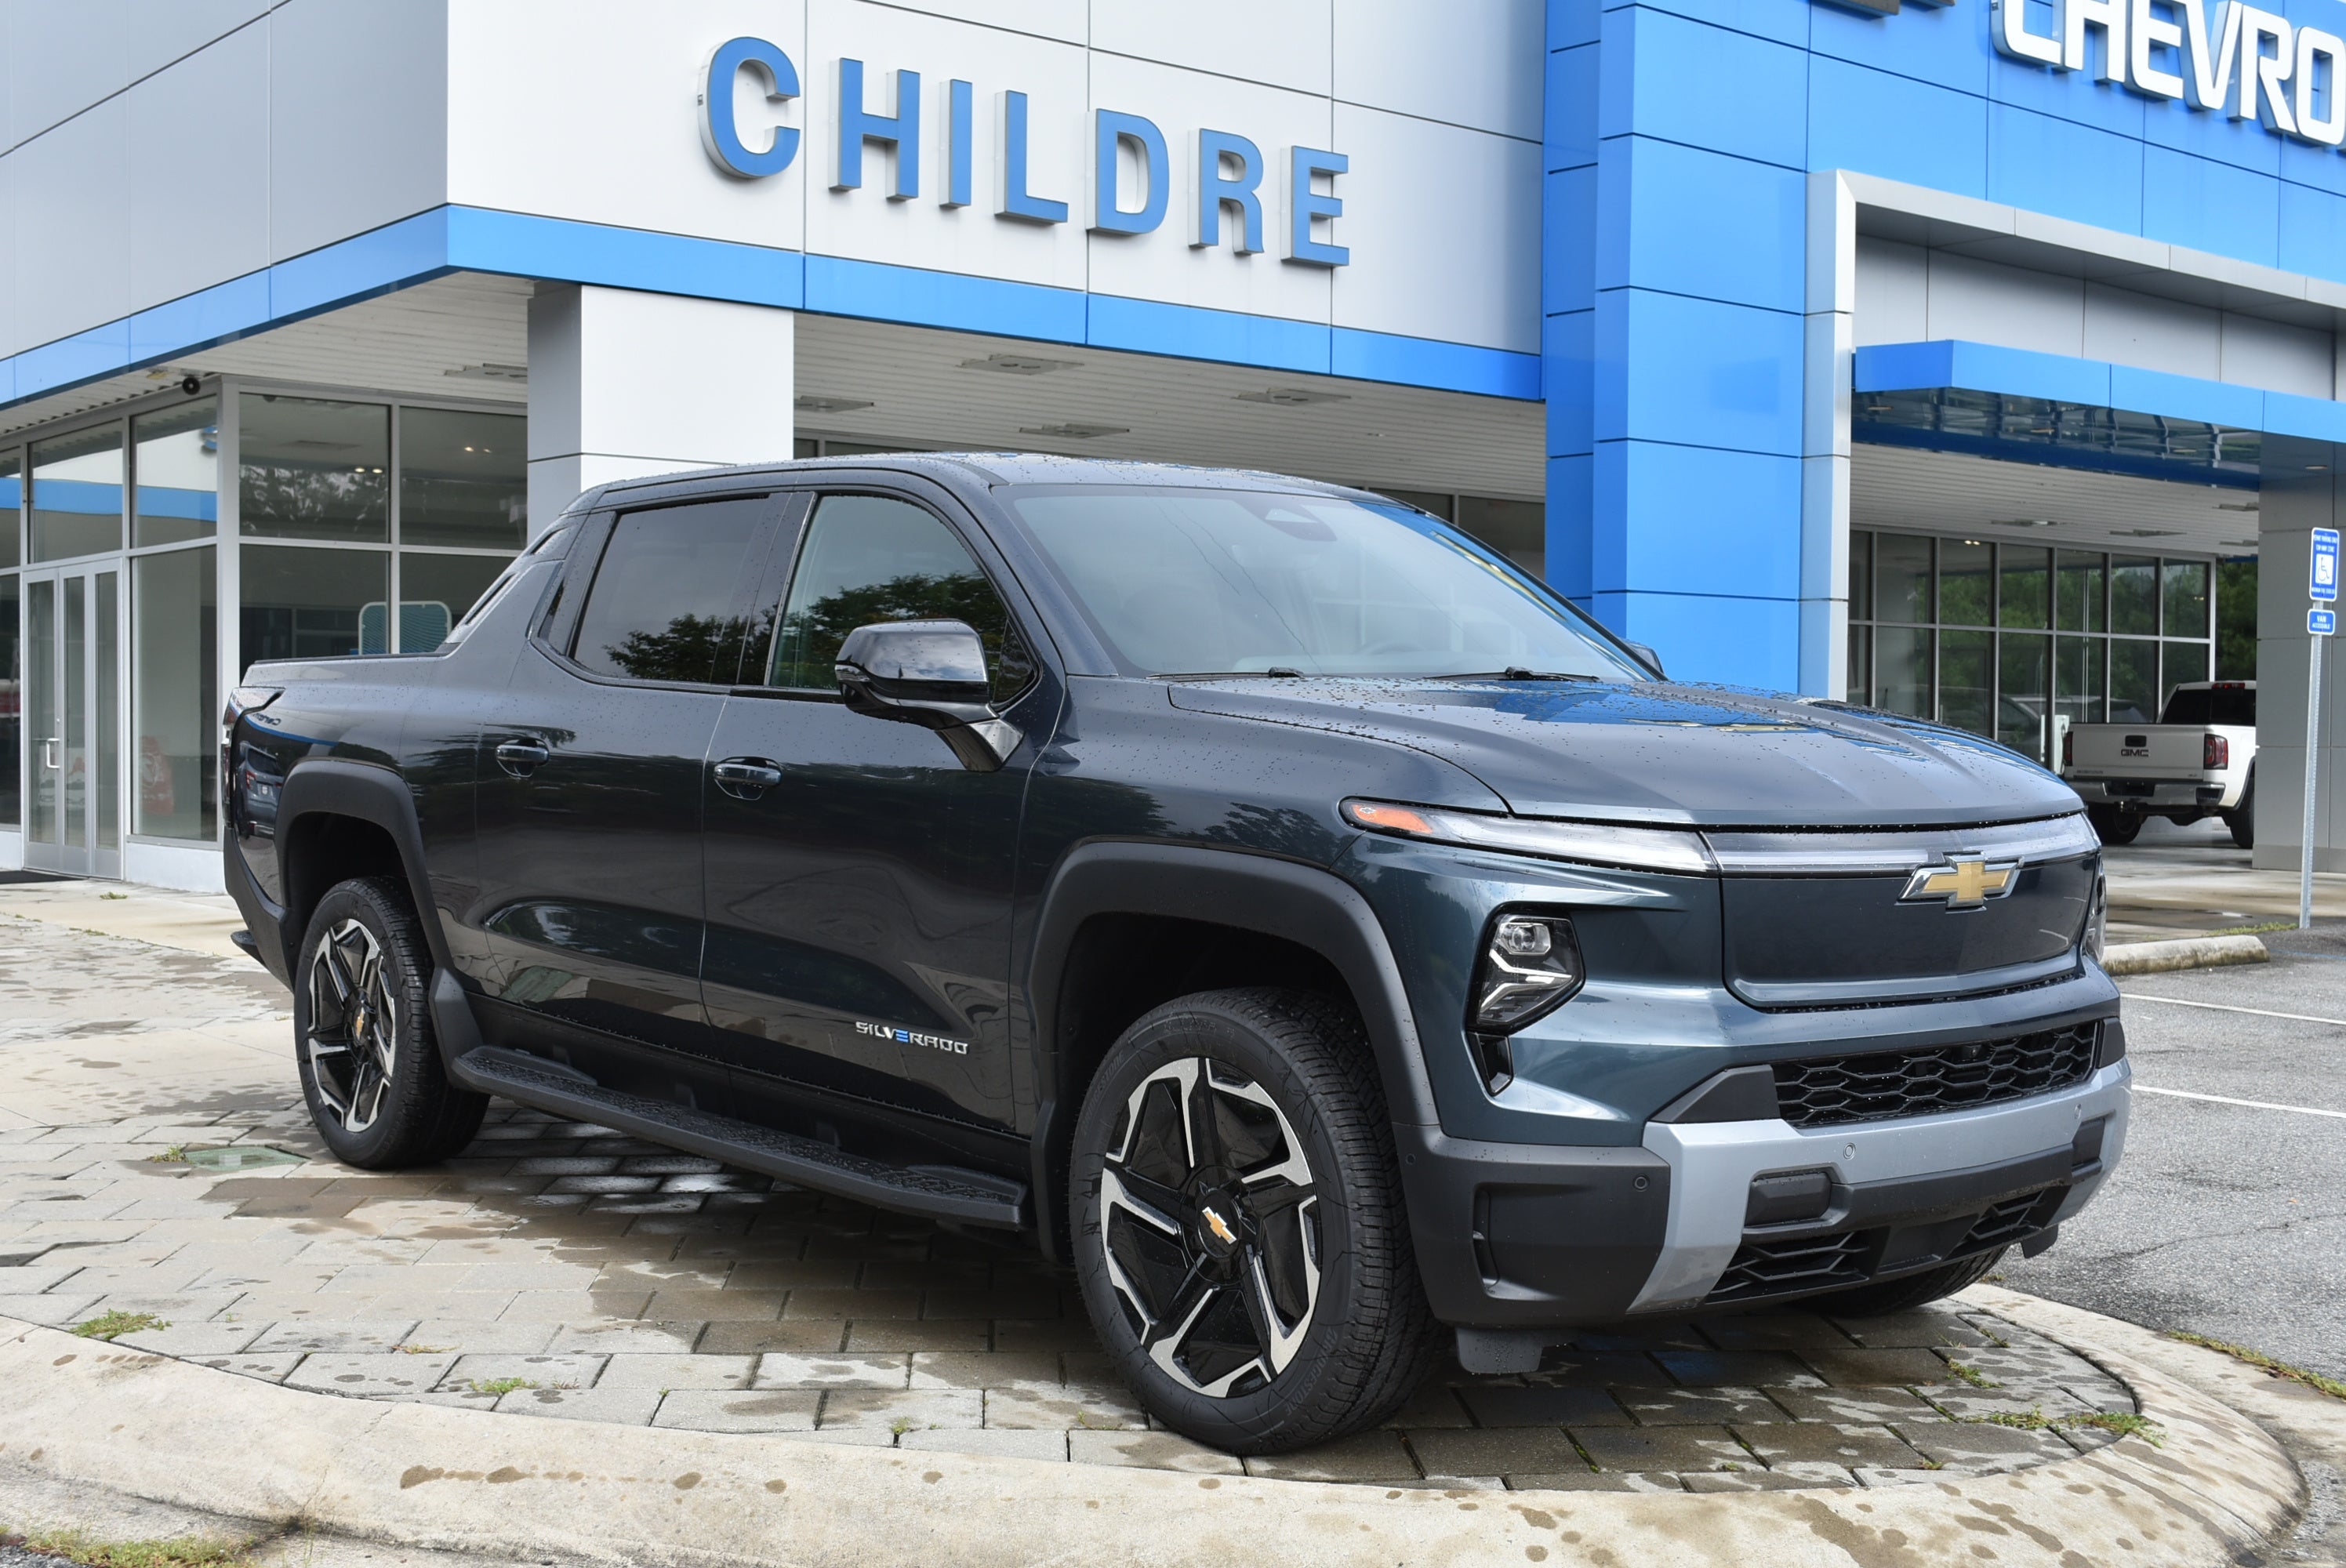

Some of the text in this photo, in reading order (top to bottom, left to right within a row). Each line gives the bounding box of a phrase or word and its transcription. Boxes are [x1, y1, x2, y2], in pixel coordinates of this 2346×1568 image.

[698, 36, 1349, 267] CHILDRE
[2120, 749, 2149, 757] GMC
[855, 1021, 968, 1055] SILVERADO
